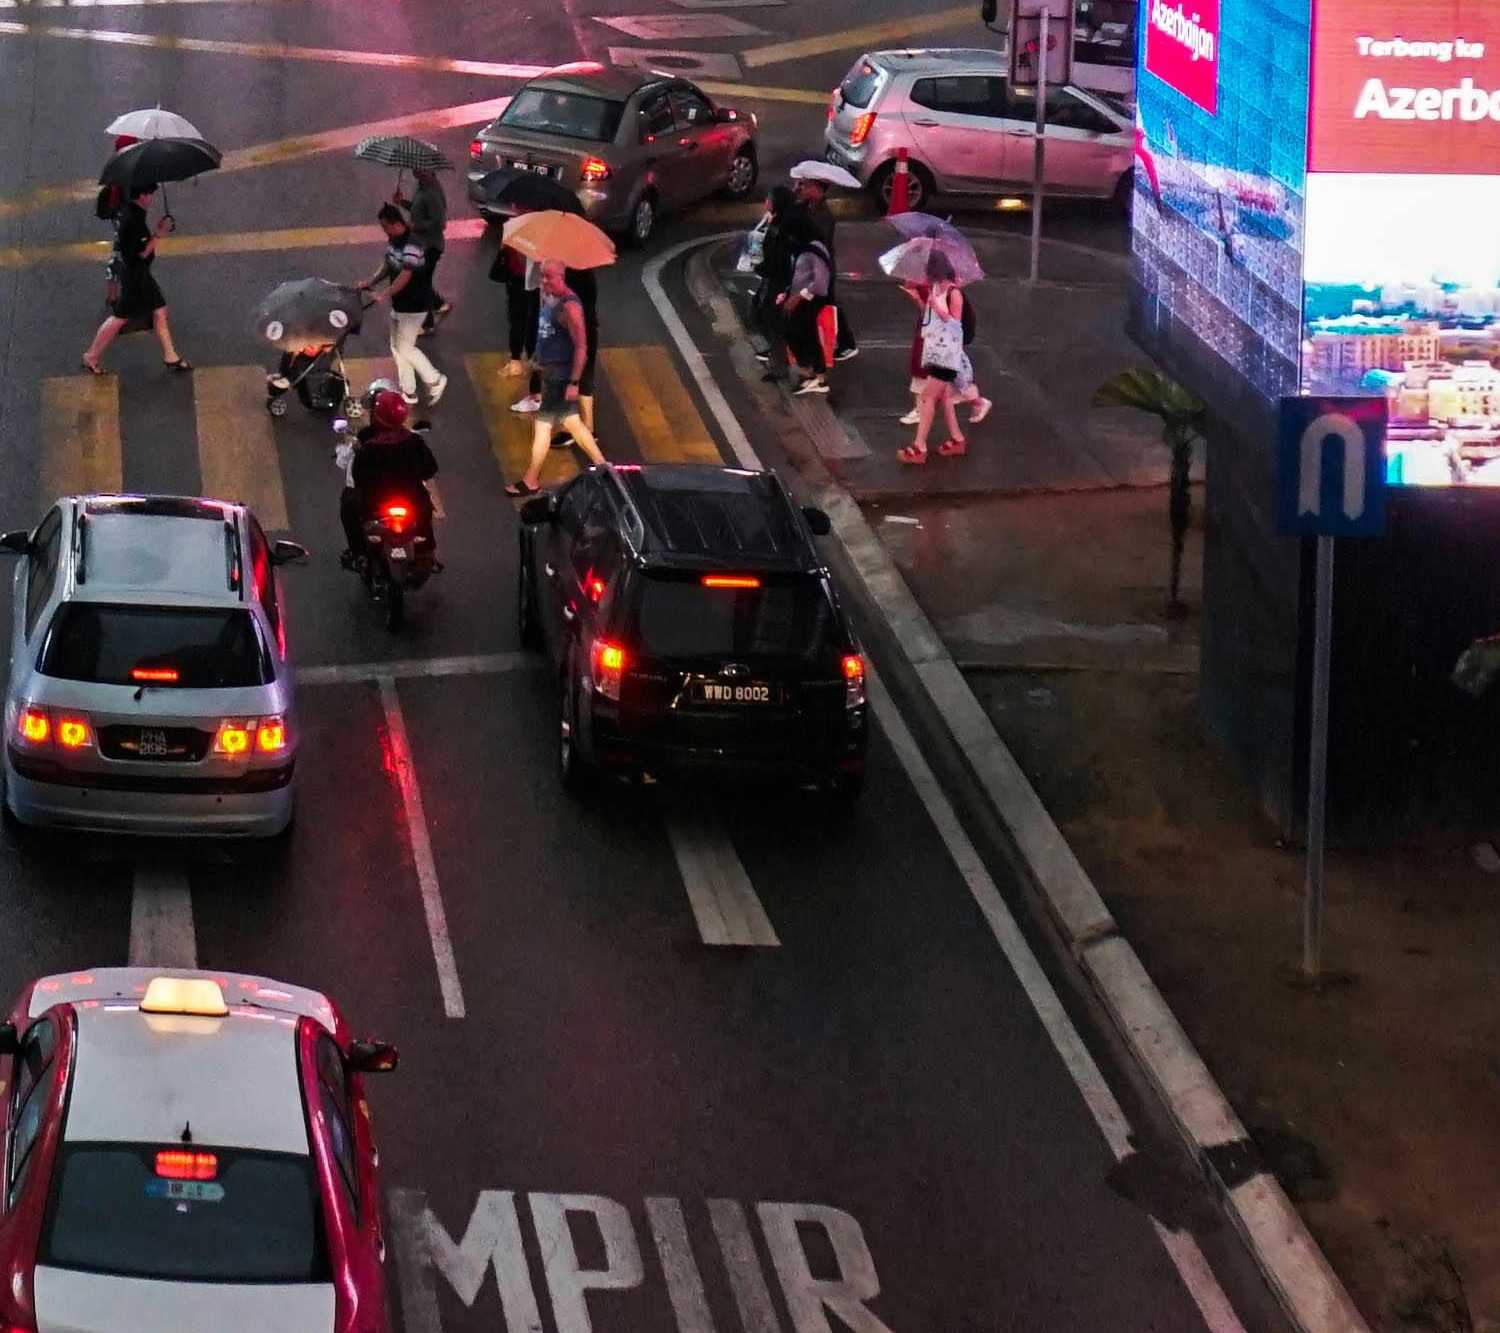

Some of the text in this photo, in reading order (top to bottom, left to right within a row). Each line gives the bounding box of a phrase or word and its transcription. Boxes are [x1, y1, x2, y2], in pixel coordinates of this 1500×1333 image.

[1355, 35, 1484, 62] Terbang ke
[704, 685, 769, 701] WWD 8002
[390, 1188, 895, 1333] MPUR
